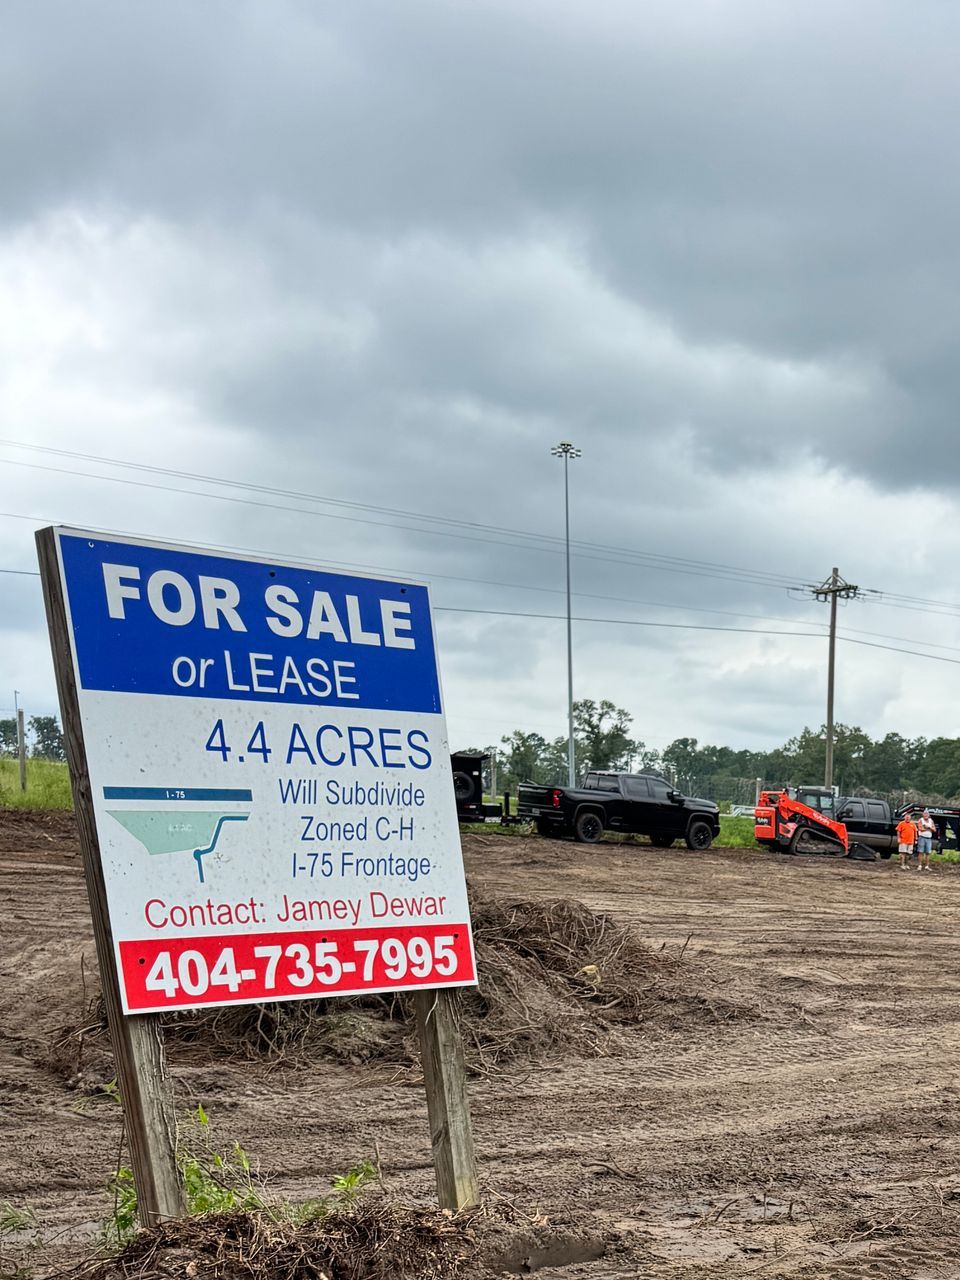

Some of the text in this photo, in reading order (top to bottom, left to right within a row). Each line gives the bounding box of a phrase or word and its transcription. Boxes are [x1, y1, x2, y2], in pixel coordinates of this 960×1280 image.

[102, 562, 416, 650] FOR SALE
[172, 650, 360, 699] or LEASE
[205, 718, 432, 770] 4.4 ACRES
[278, 778, 425, 807] Will Subdivide
[300, 816, 414, 841] Zoned C-H
[292, 852, 431, 882] I-75 Frontage
[144, 891, 447, 929] Contact: Jamey Dewar
[144, 935, 459, 998] 404-735-7995
